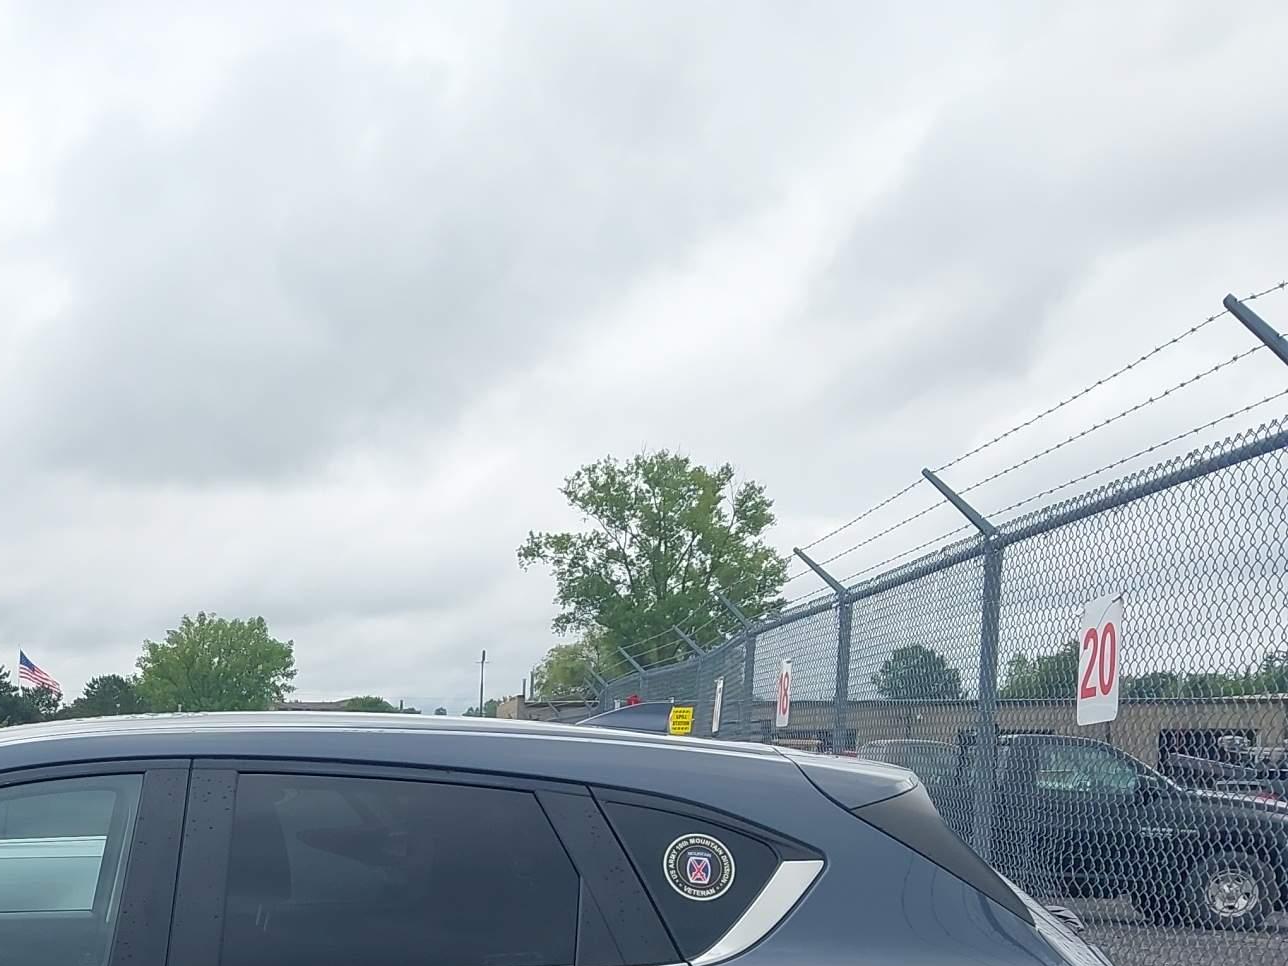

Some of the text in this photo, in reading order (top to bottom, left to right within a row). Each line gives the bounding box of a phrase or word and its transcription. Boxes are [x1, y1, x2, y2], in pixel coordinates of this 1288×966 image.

[1080, 622, 1116, 699] 20
[779, 671, 790, 716] 18
[668, 837, 731, 884] US ARMY 10th MOUNTAIN DIVISION
[683, 885, 716, 897] VETERAN
